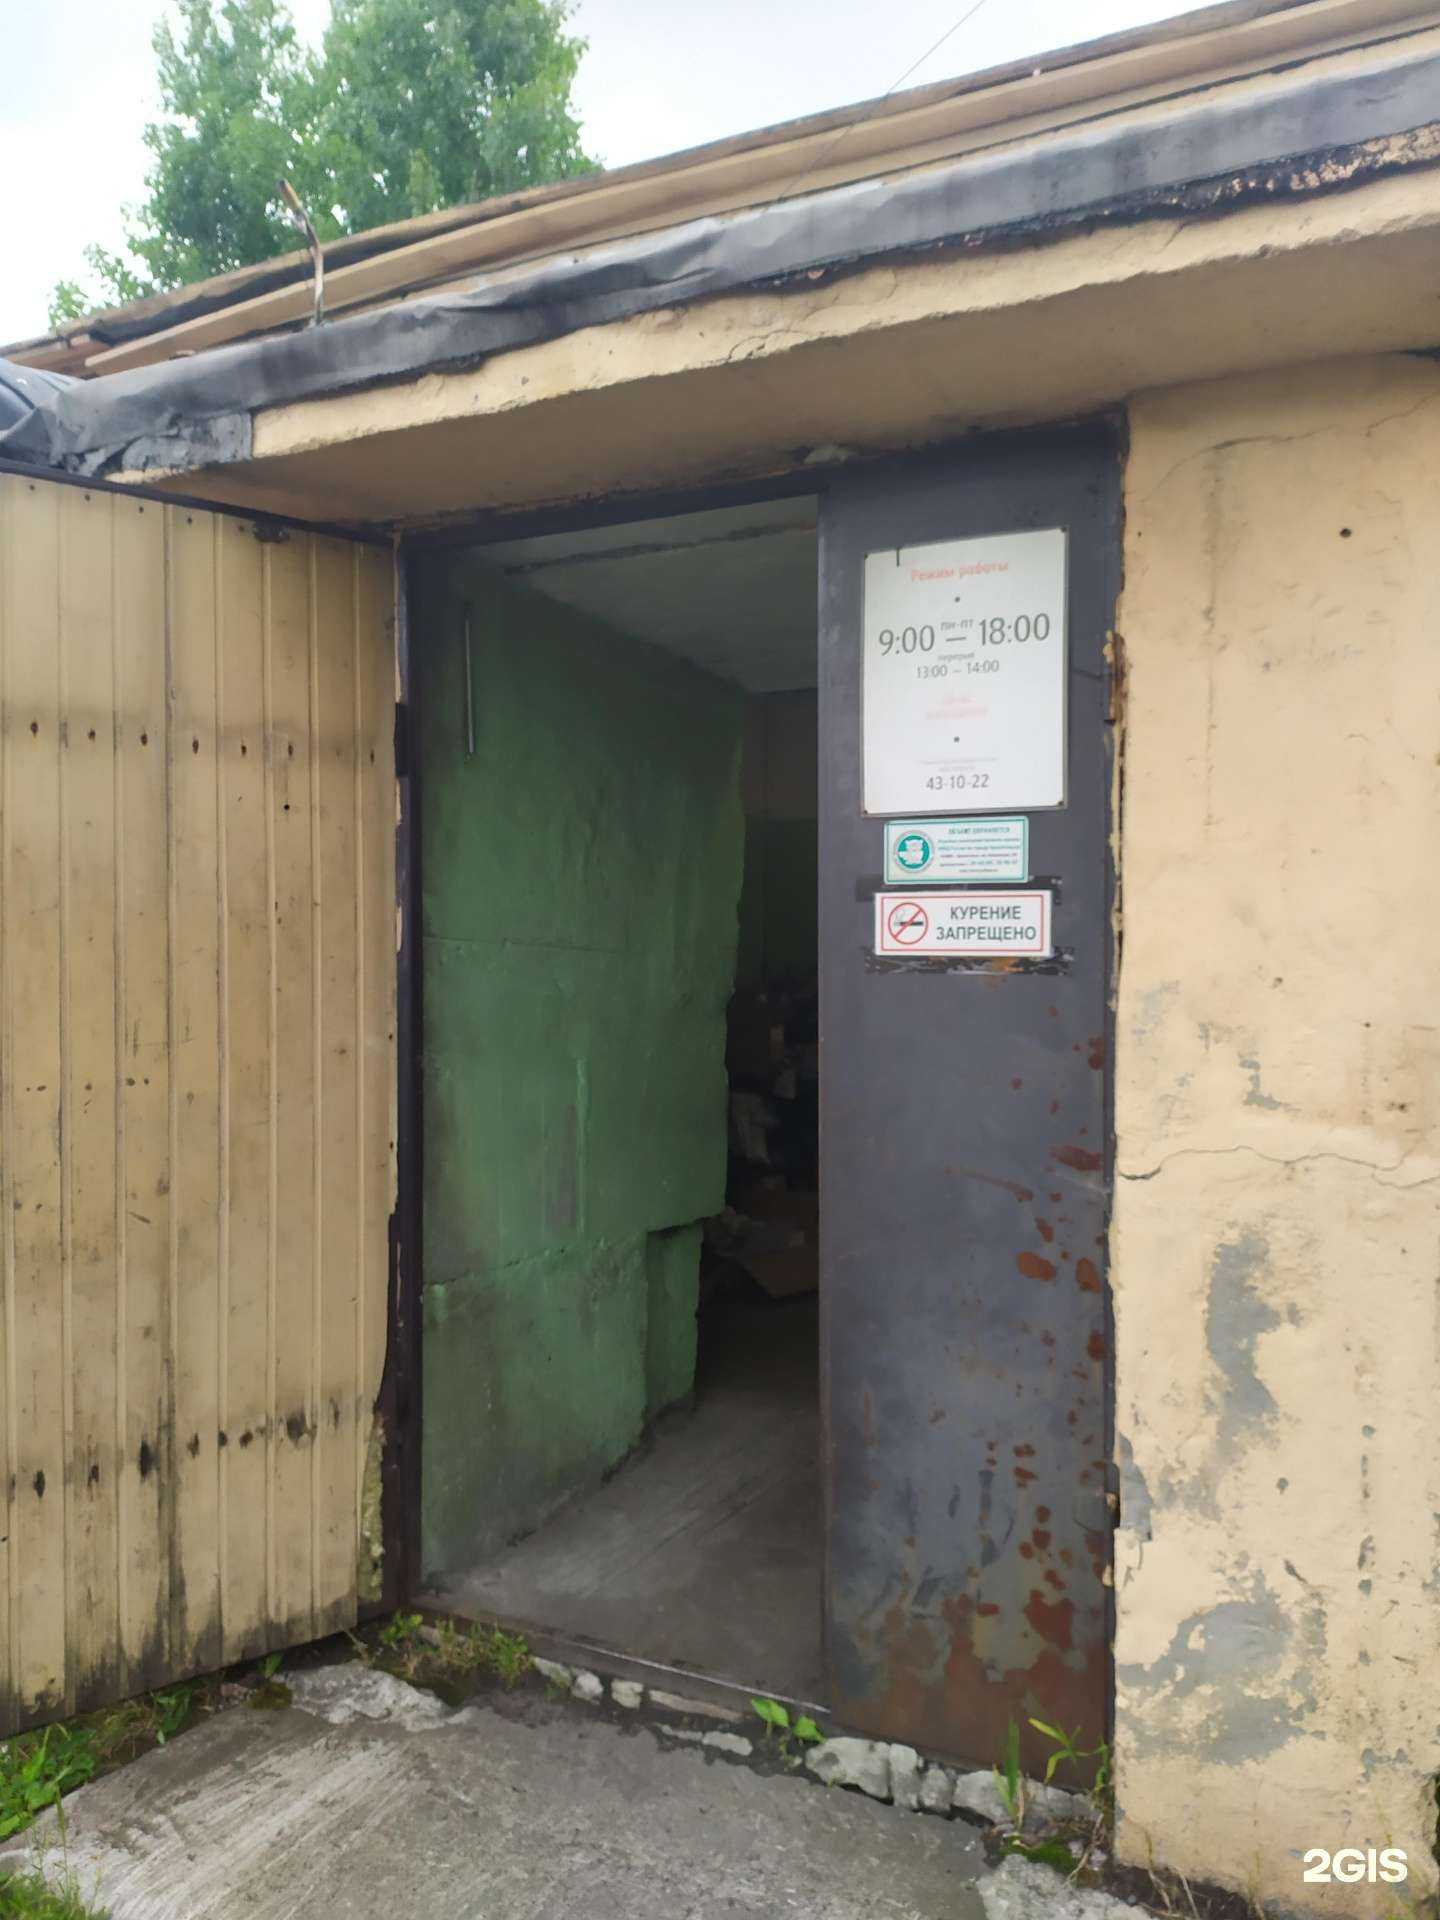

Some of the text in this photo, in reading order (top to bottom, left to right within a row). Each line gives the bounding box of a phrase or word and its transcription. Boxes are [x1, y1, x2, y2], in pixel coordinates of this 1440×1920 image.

[911, 561, 1009, 582] Режим работы
[878, 625, 935, 656] 9:00
[979, 613, 1050, 645] 18:00
[916, 664, 948, 679] 13:00
[967, 659, 1000, 675] 14:00
[925, 773, 990, 790] 43-10-22
[950, 906, 1021, 920] КУРЕНИЕ
[936, 926, 1037, 942] ЗАПРЕЩЕНО
